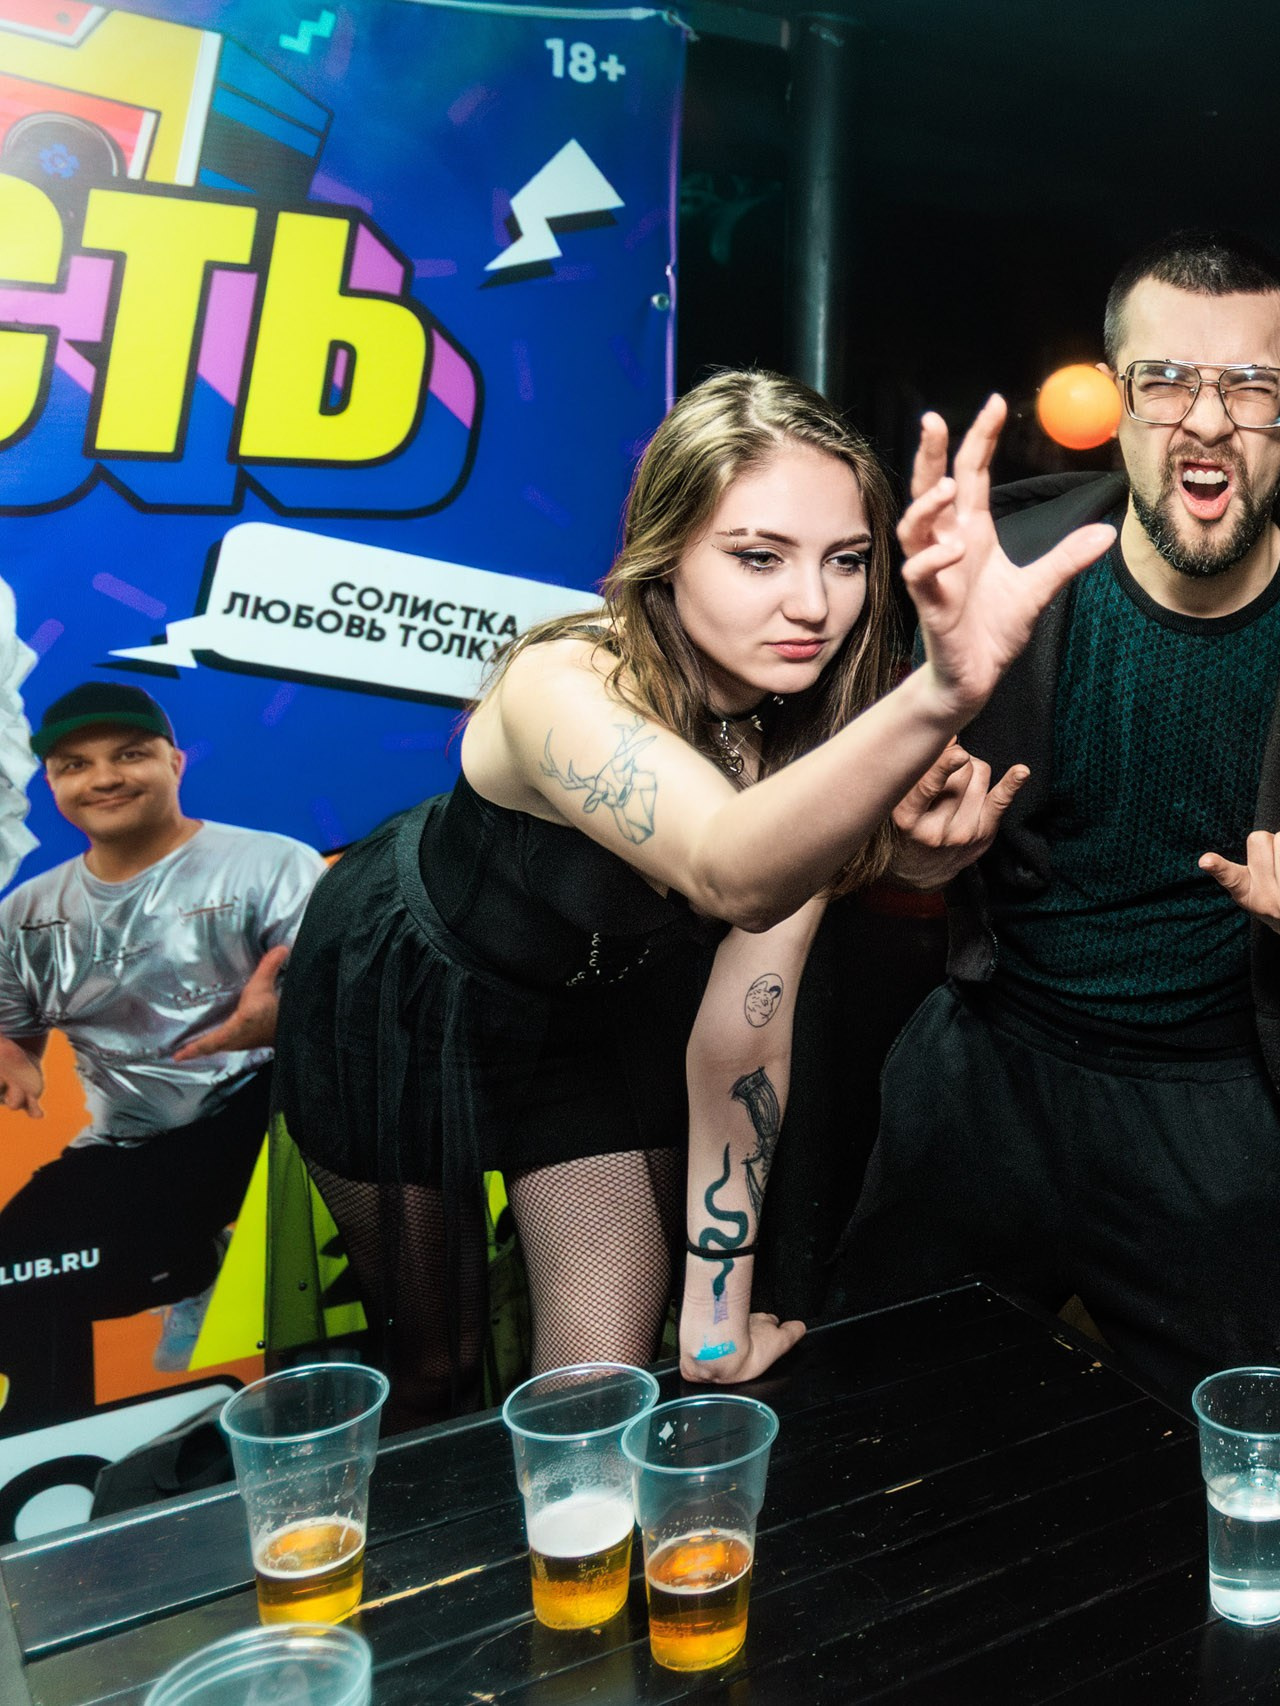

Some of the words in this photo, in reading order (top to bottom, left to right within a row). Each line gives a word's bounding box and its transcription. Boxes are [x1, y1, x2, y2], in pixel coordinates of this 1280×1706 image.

[545, 38, 626, 83] 18+
[223, 591, 386, 642] ЛЮБОВЬ
[331, 582, 518, 639] СОЛИСТКА
